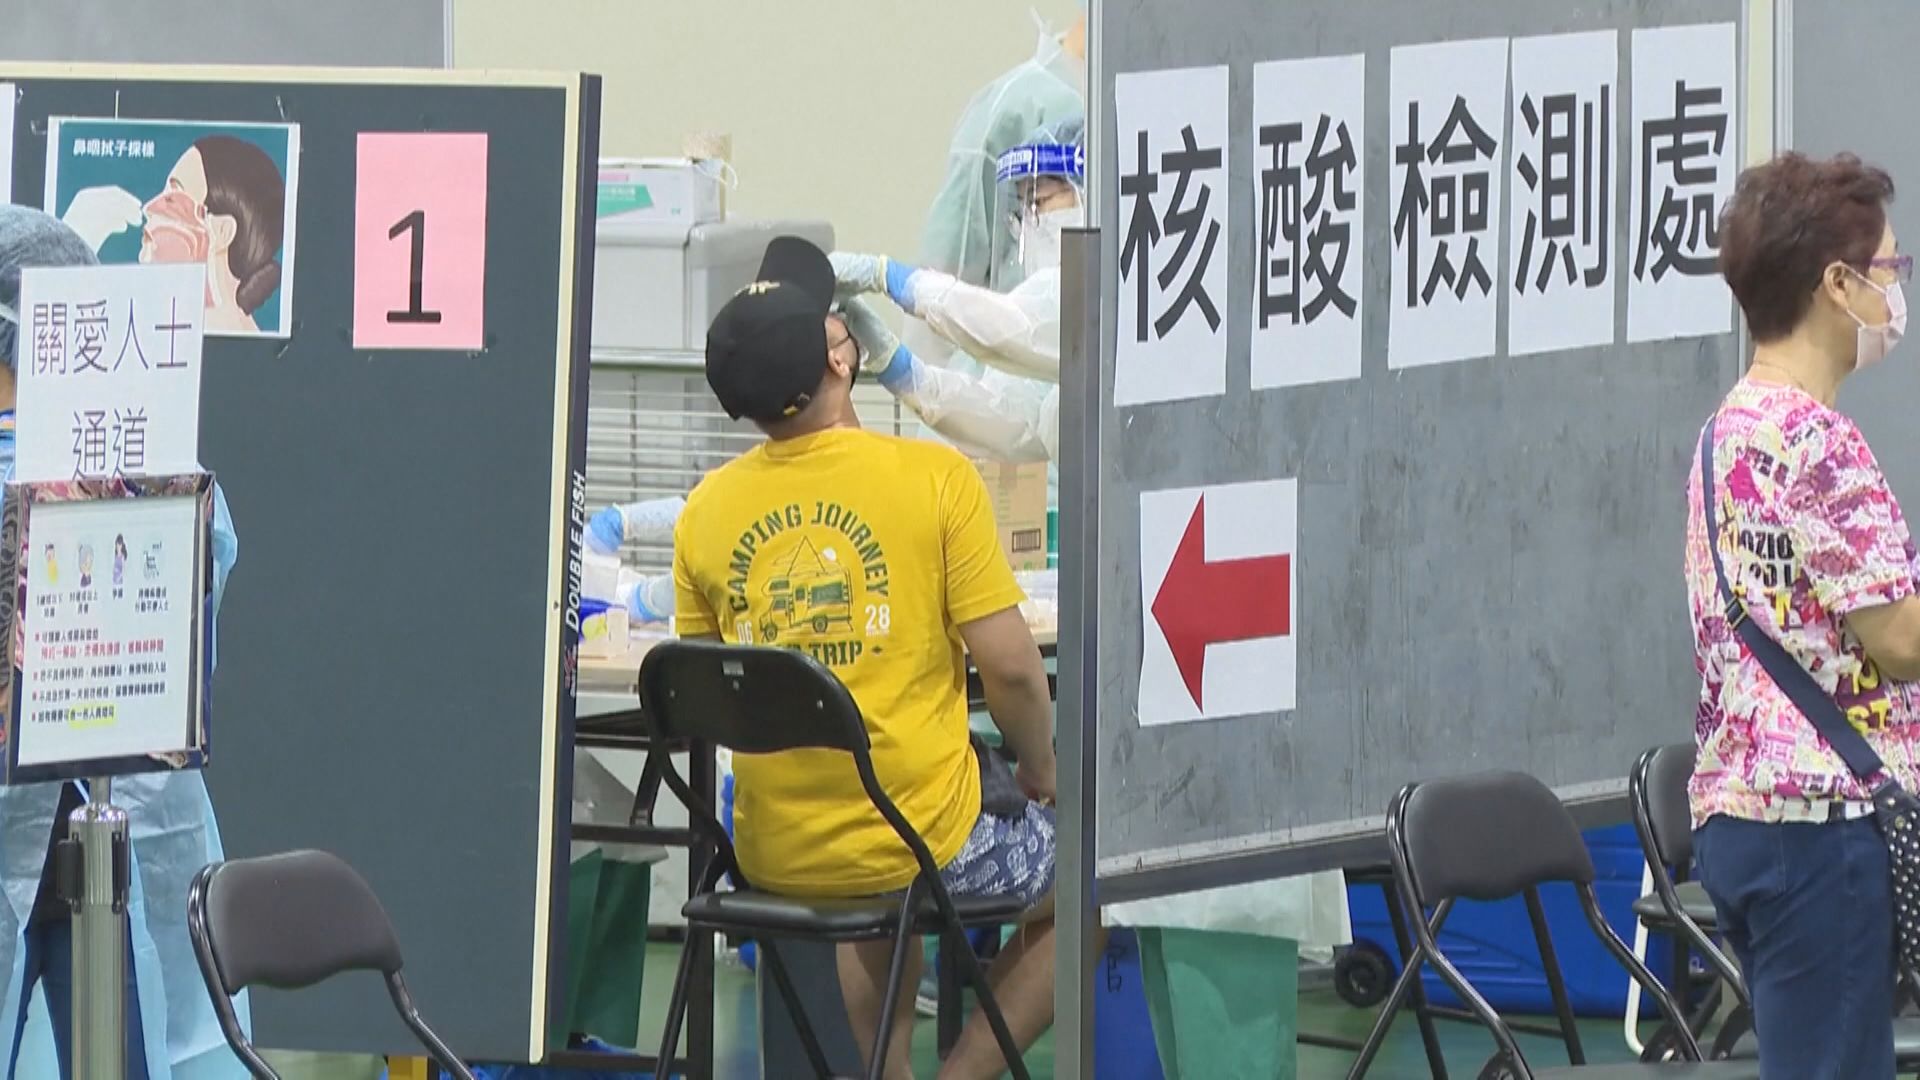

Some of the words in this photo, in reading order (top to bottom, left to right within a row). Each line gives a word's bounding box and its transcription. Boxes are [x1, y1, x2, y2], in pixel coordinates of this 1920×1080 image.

[1119, 80, 1728, 343] 核酸檢測處
[387, 210, 441, 323] 1
[32, 296, 192, 376] 關愛人士
[72, 406, 148, 480] 通道
[571, 469, 585, 525] FISH
[565, 528, 582, 634] DOUBLE
[728, 504, 802, 612] CAMPING
[811, 501, 889, 597] JOURNEY
[808, 640, 863, 666] TRIP
[865, 604, 890, 630] 28
